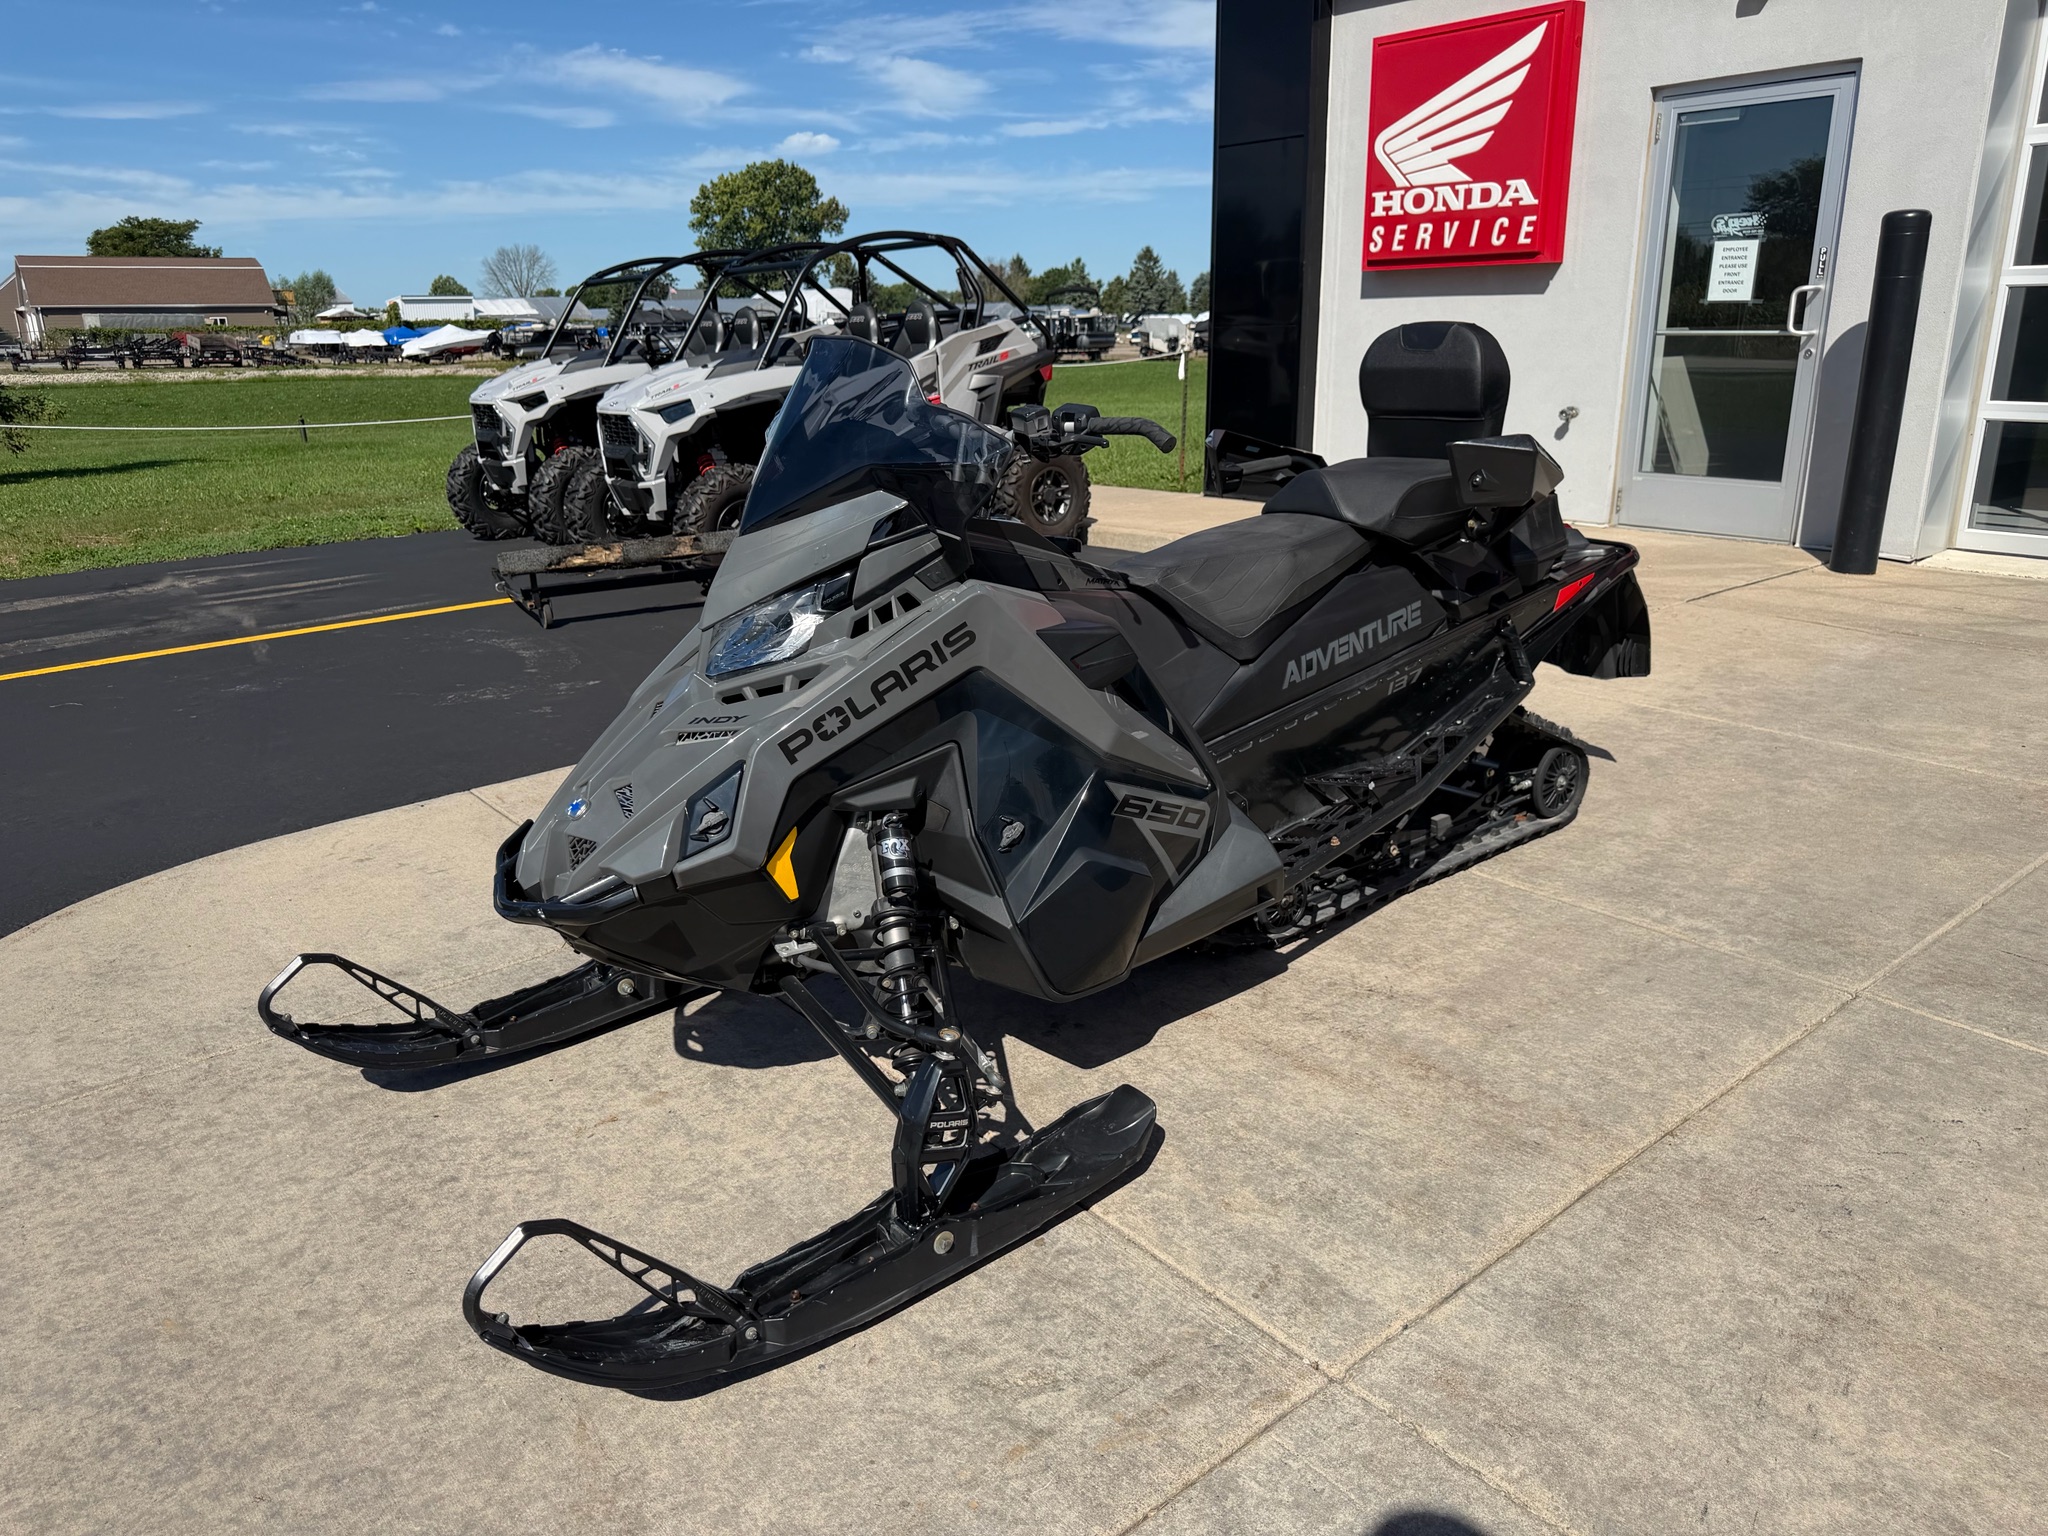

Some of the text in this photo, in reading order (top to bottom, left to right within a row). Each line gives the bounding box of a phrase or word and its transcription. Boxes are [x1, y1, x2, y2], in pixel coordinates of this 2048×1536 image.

[1370, 179, 1539, 217] HONDA
[1369, 215, 1538, 253] SERVICE
[1818, 247, 1827, 275] PULL
[968, 355, 999, 372] TRAIL
[1282, 600, 1422, 690] ADVENTURE
[777, 621, 977, 765] POLARIS
[1387, 667, 1423, 695] 137
[688, 715, 750, 725] INDY
[1113, 794, 1206, 830] 650
[881, 838, 911, 859] FOX
[930, 1119, 969, 1129] POLARIS
